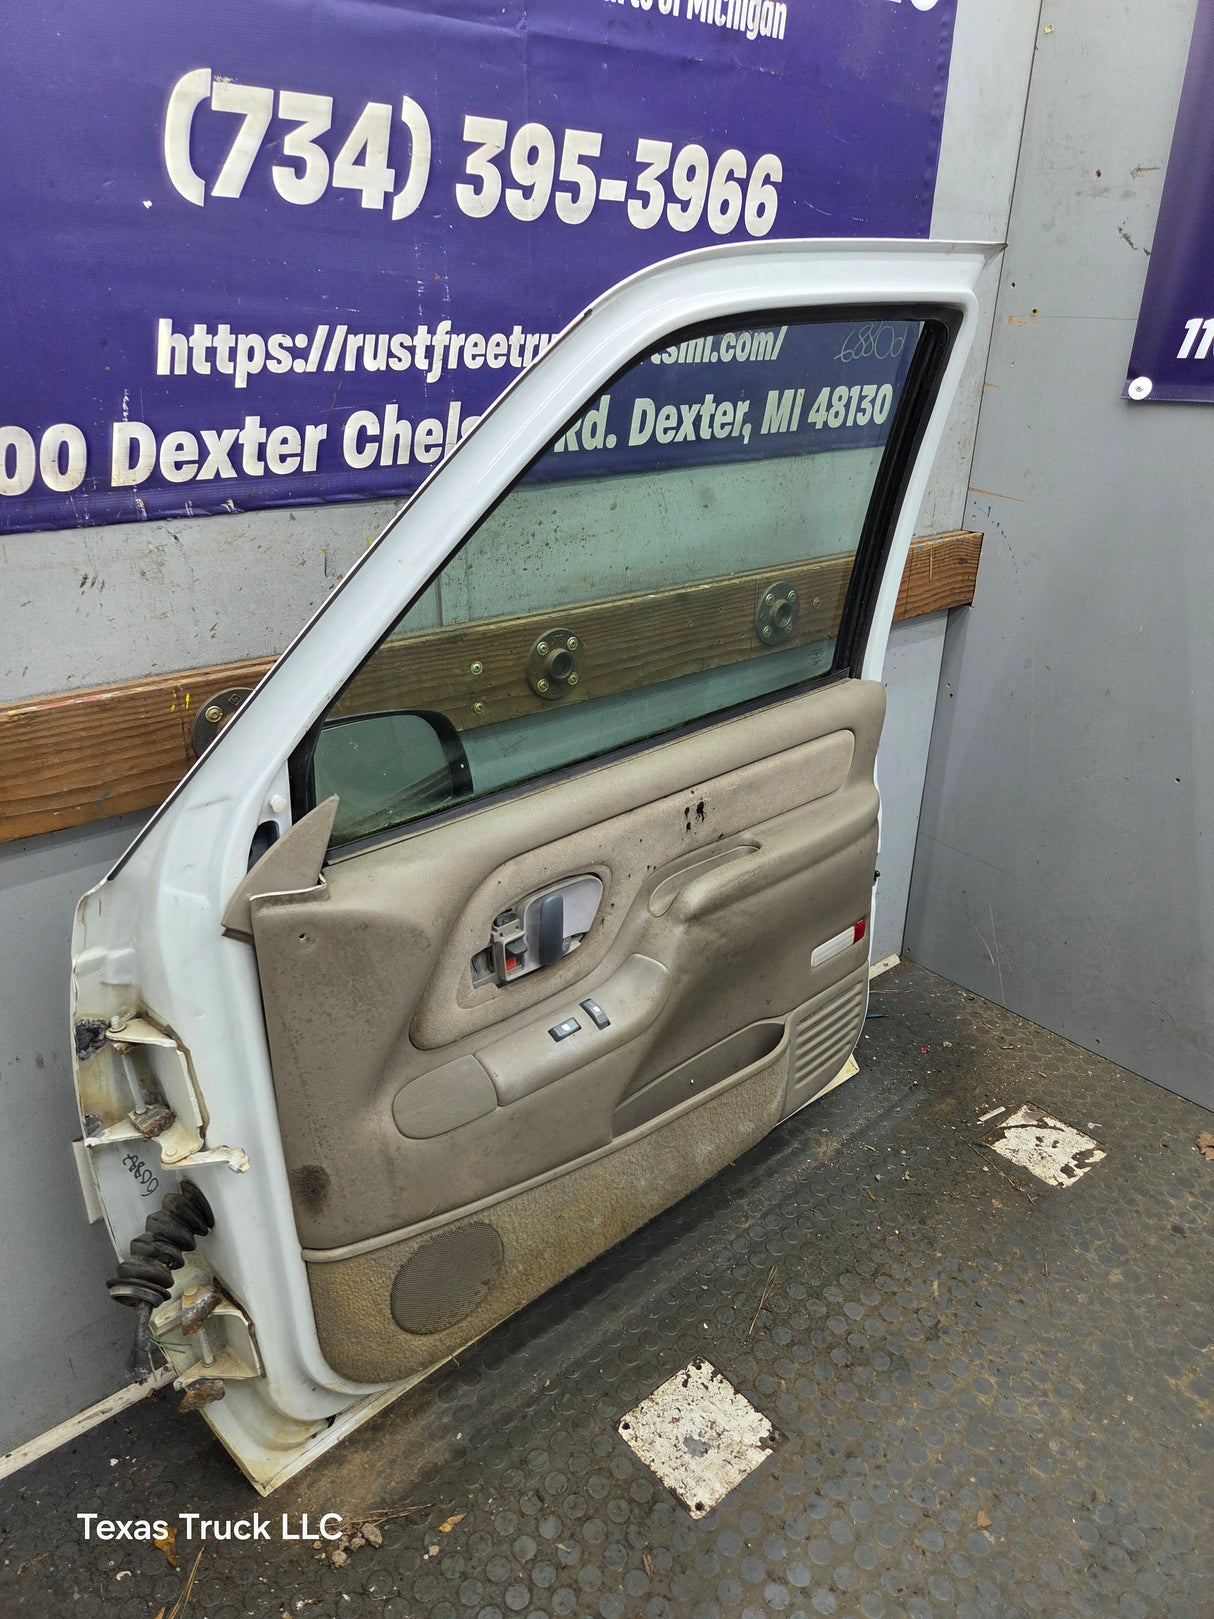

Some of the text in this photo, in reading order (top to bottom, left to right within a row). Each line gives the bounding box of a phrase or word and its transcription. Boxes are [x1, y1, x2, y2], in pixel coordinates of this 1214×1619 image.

[164, 68, 783, 237] (734) 395-3966
[110, 416, 327, 488] Dexter
[628, 394, 752, 445] Dexter,
[760, 388, 806, 434] MI
[807, 384, 893, 430] 48130
